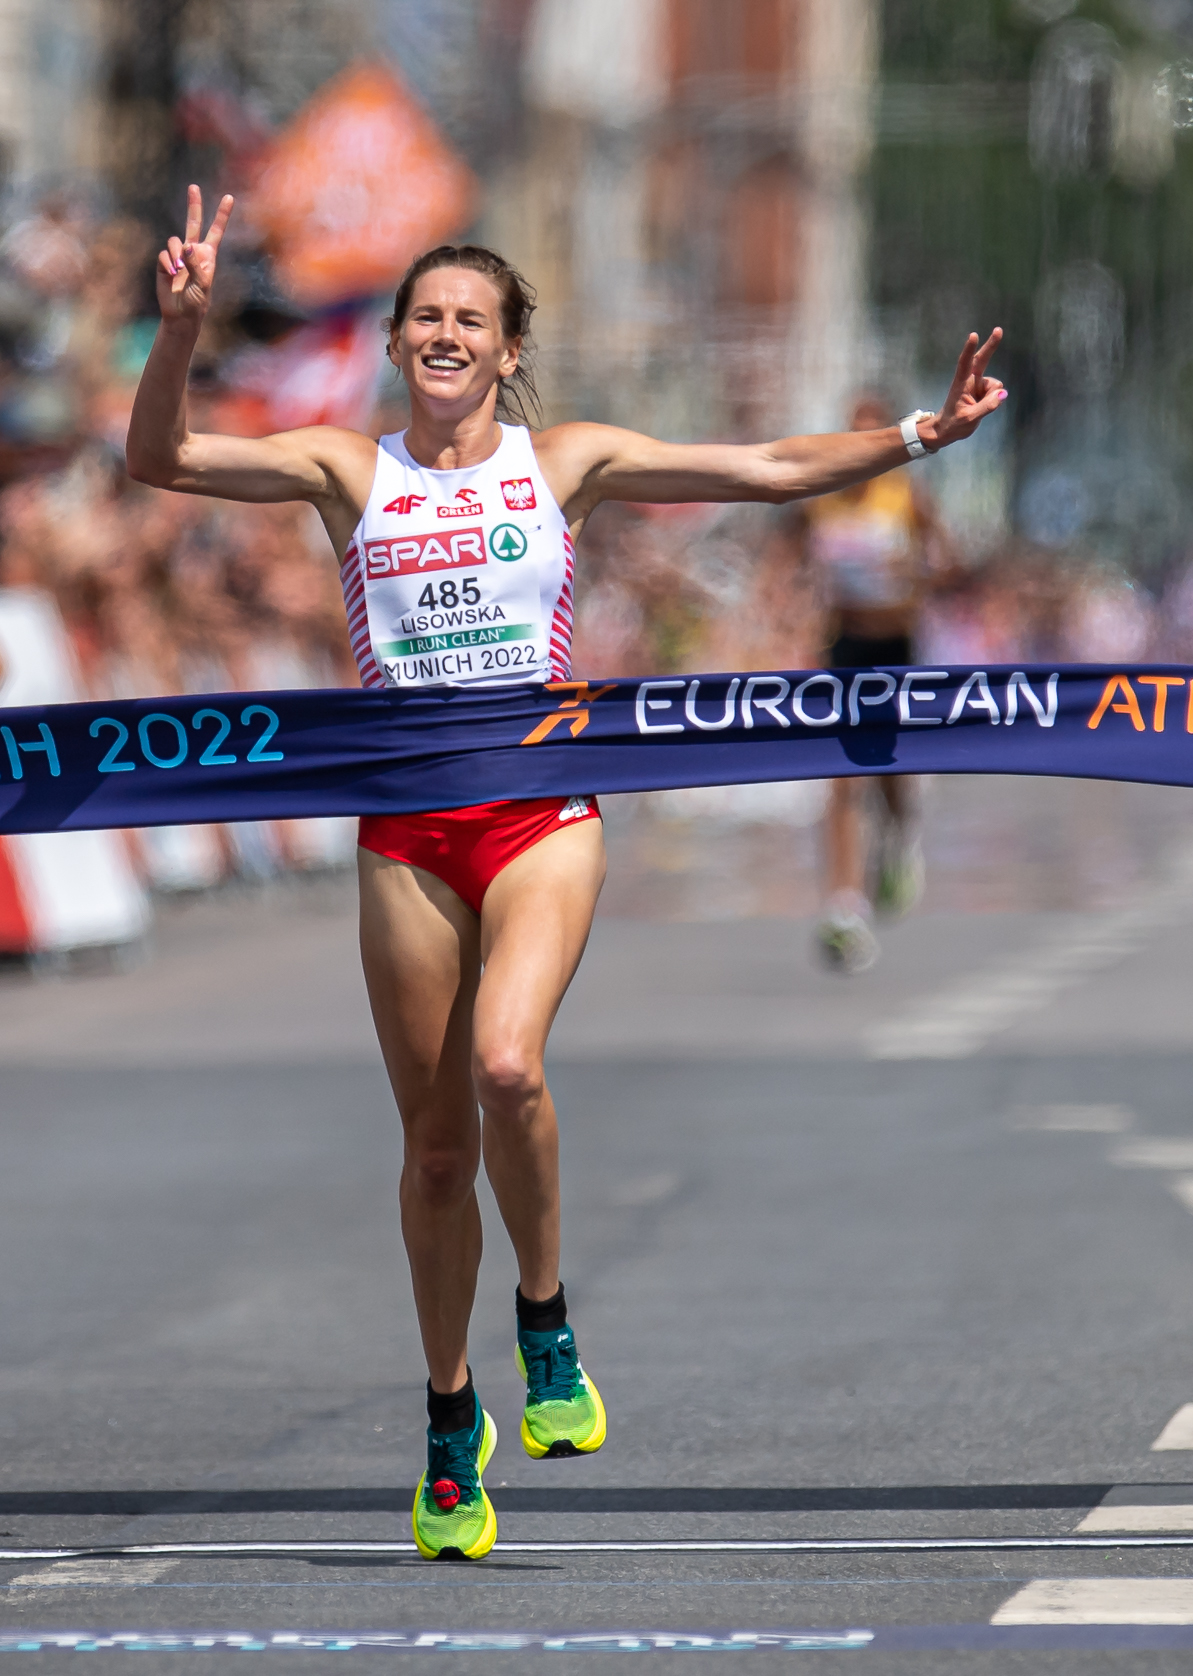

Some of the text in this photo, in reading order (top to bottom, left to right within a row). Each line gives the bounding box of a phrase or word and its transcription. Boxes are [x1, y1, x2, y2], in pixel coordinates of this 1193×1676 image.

[438, 505, 481, 517] ORLEN
[369, 532, 484, 574] SPAR
[417, 576, 481, 611] 485
[401, 605, 506, 634] LISOWSKA
[409, 641, 414, 653] I
[416, 636, 448, 652] RUN
[383, 645, 537, 682] MUNICH 2022
[635, 671, 1193, 735] EUROPEAN AT
[89, 705, 284, 773] 2022
